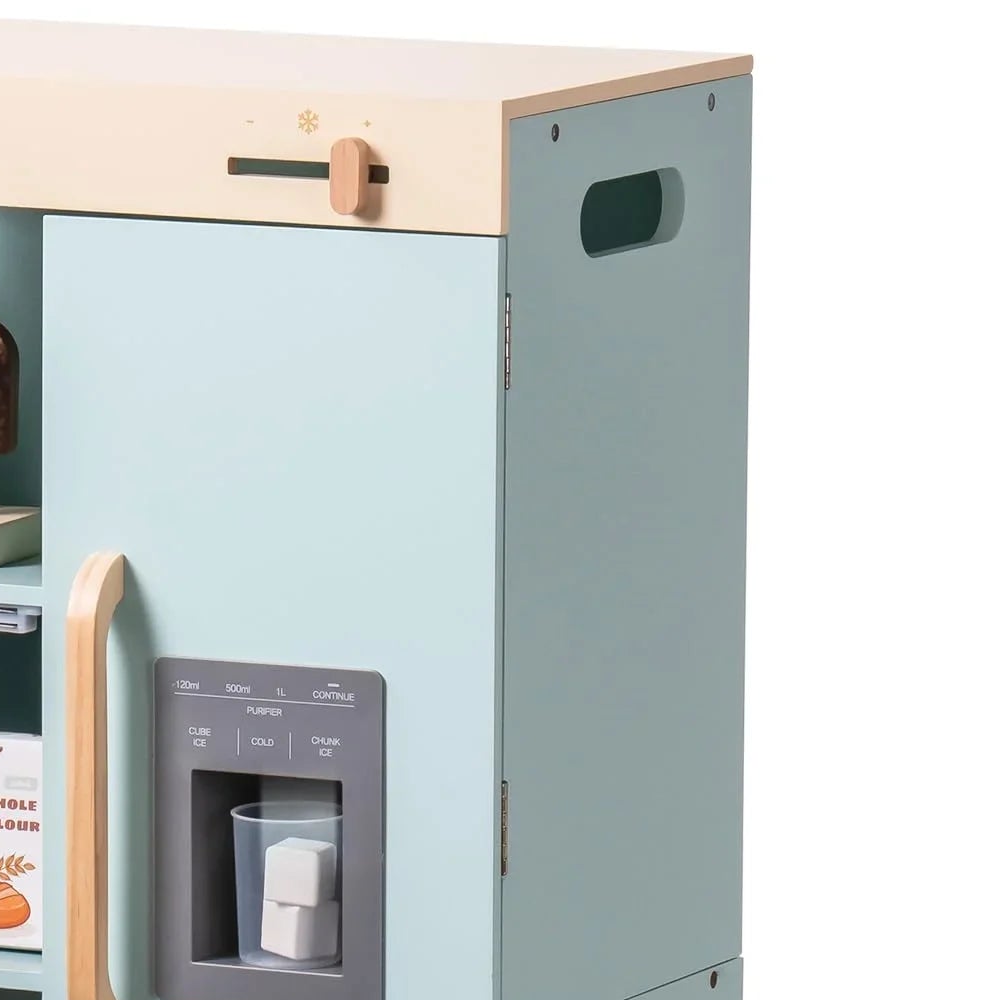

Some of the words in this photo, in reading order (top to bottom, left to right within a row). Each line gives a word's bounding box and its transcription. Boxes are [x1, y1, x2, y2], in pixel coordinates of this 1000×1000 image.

[225, 684, 251, 694] 500ml
[276, 687, 286, 697] 1L
[312, 690, 355, 702] CONTINUE
[247, 706, 283, 717] PURIFIER
[188, 726, 211, 737] CUBE
[193, 738, 207, 748] ICE
[251, 737, 274, 747] COLD
[311, 736, 341, 747] CHUNK
[319, 747, 332, 757] ICE
